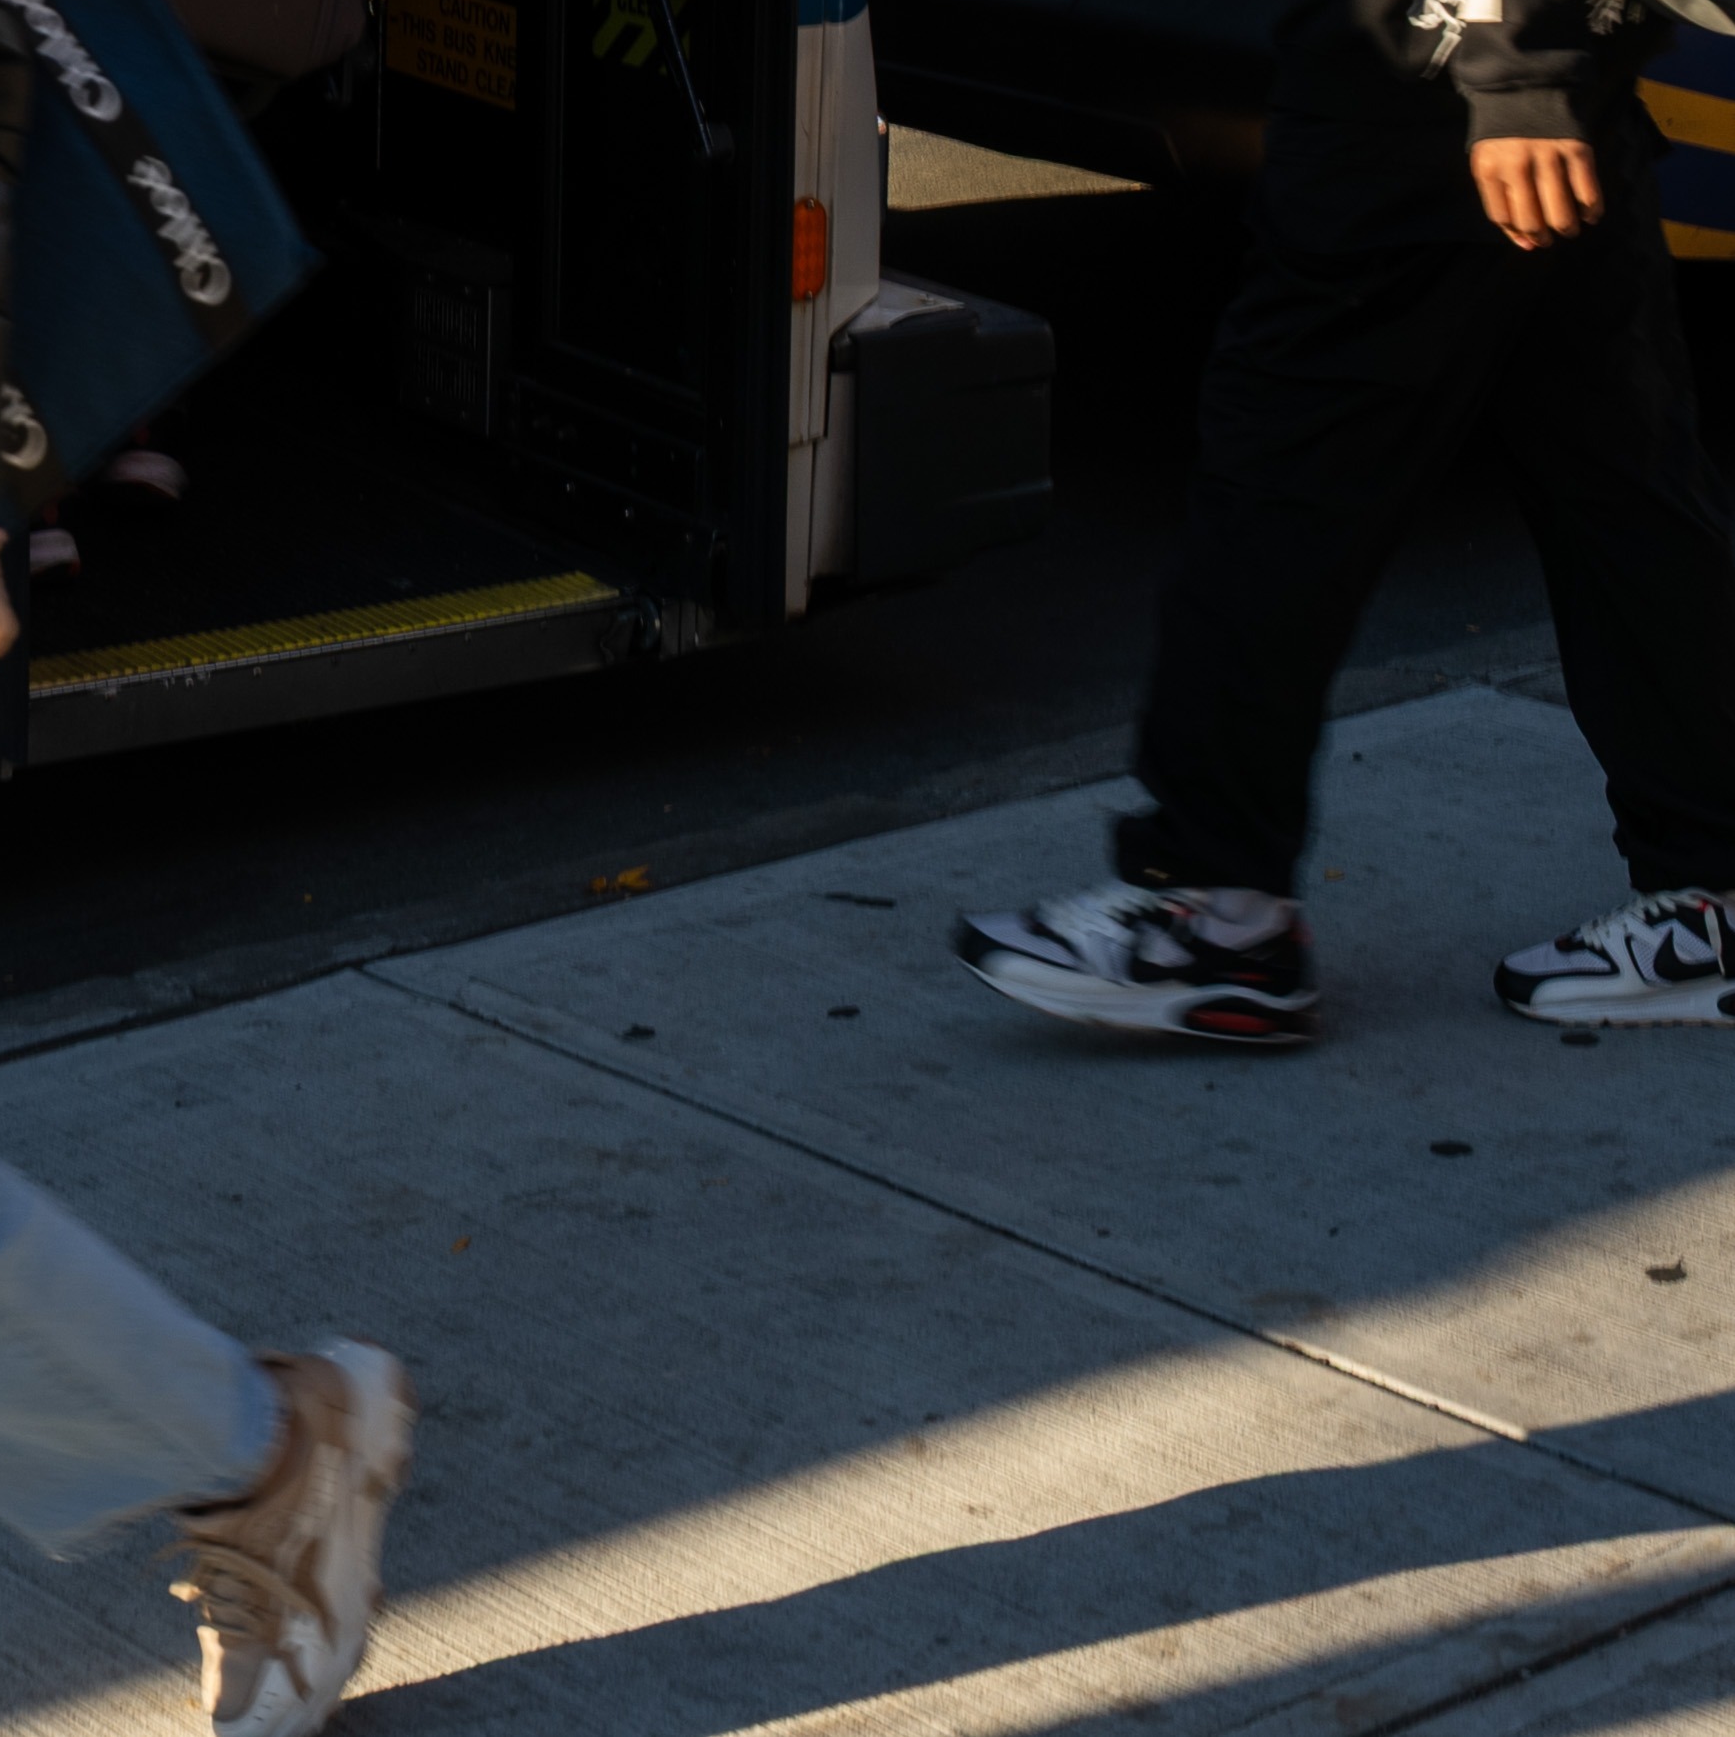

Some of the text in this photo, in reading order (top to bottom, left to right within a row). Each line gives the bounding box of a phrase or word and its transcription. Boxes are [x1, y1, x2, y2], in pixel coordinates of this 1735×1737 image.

[400, 11, 516, 70] THIS BUS KNE
[416, 47, 515, 102] STAND CLEA
